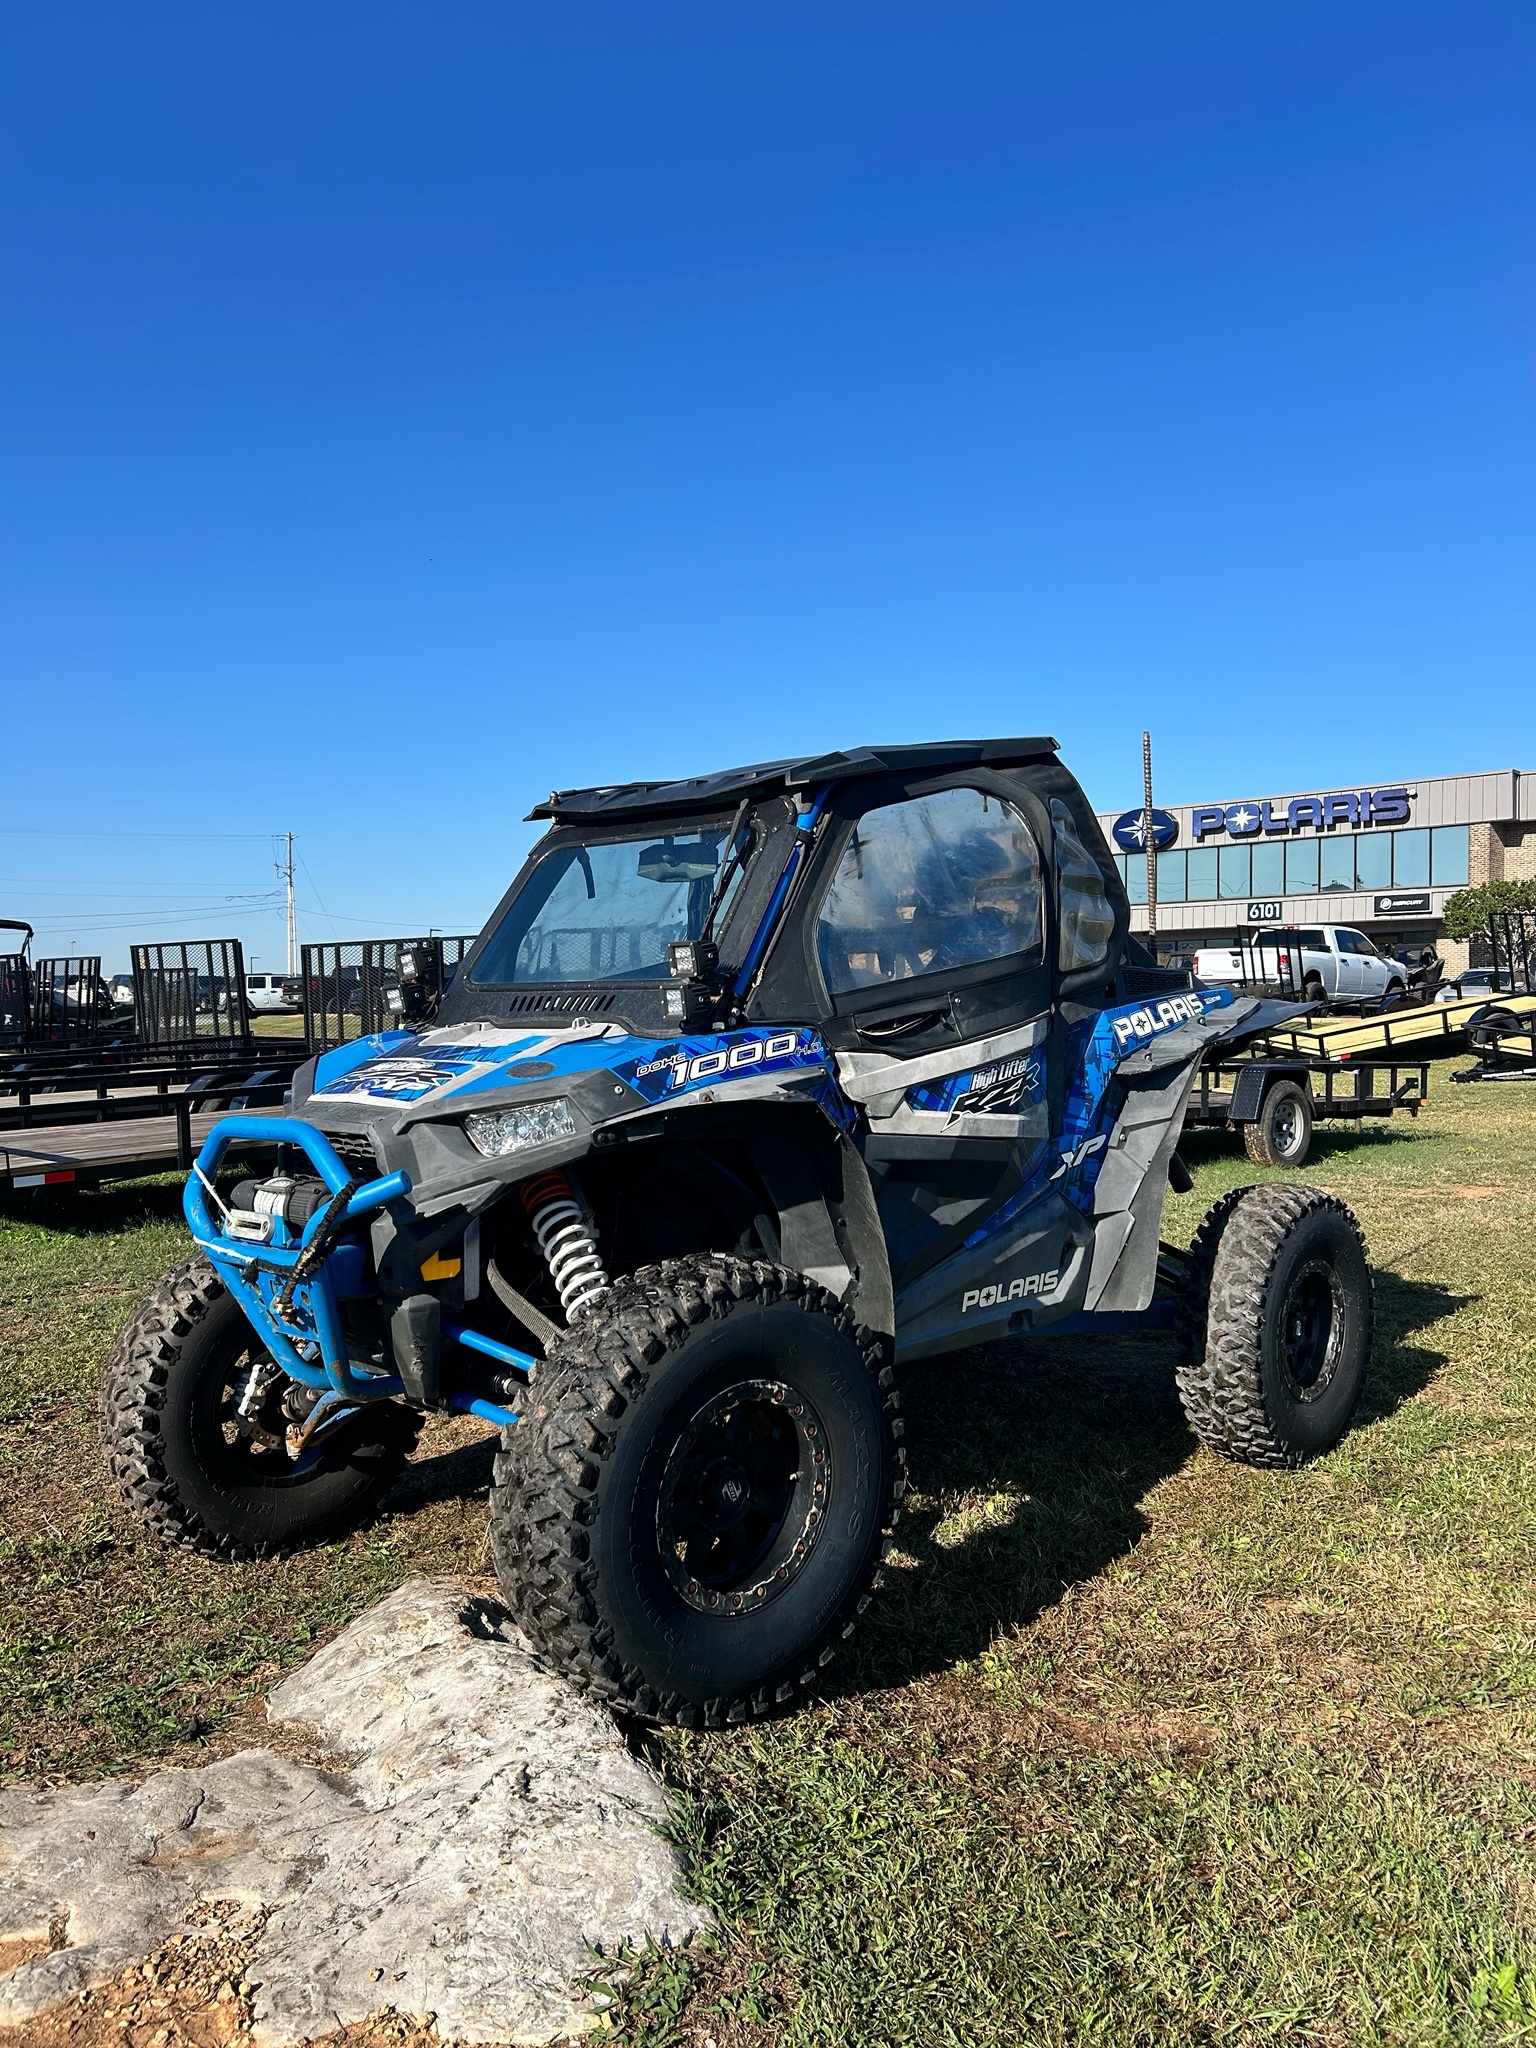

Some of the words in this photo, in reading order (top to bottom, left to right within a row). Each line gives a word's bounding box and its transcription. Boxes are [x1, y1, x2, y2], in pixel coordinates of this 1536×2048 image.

[1192, 788, 1408, 837] POLARIS
[1249, 903, 1280, 919] 6101
[1111, 993, 1204, 1045] POLARIS
[636, 1052, 686, 1077] DOHC
[671, 1032, 797, 1089] 1000
[970, 1066, 998, 1090] High
[998, 1056, 1031, 1081] Lifter
[1049, 1134, 1107, 1181] XP
[961, 1269, 1059, 1313] POLARIS
[825, 1370, 870, 1542] MAXXIS
